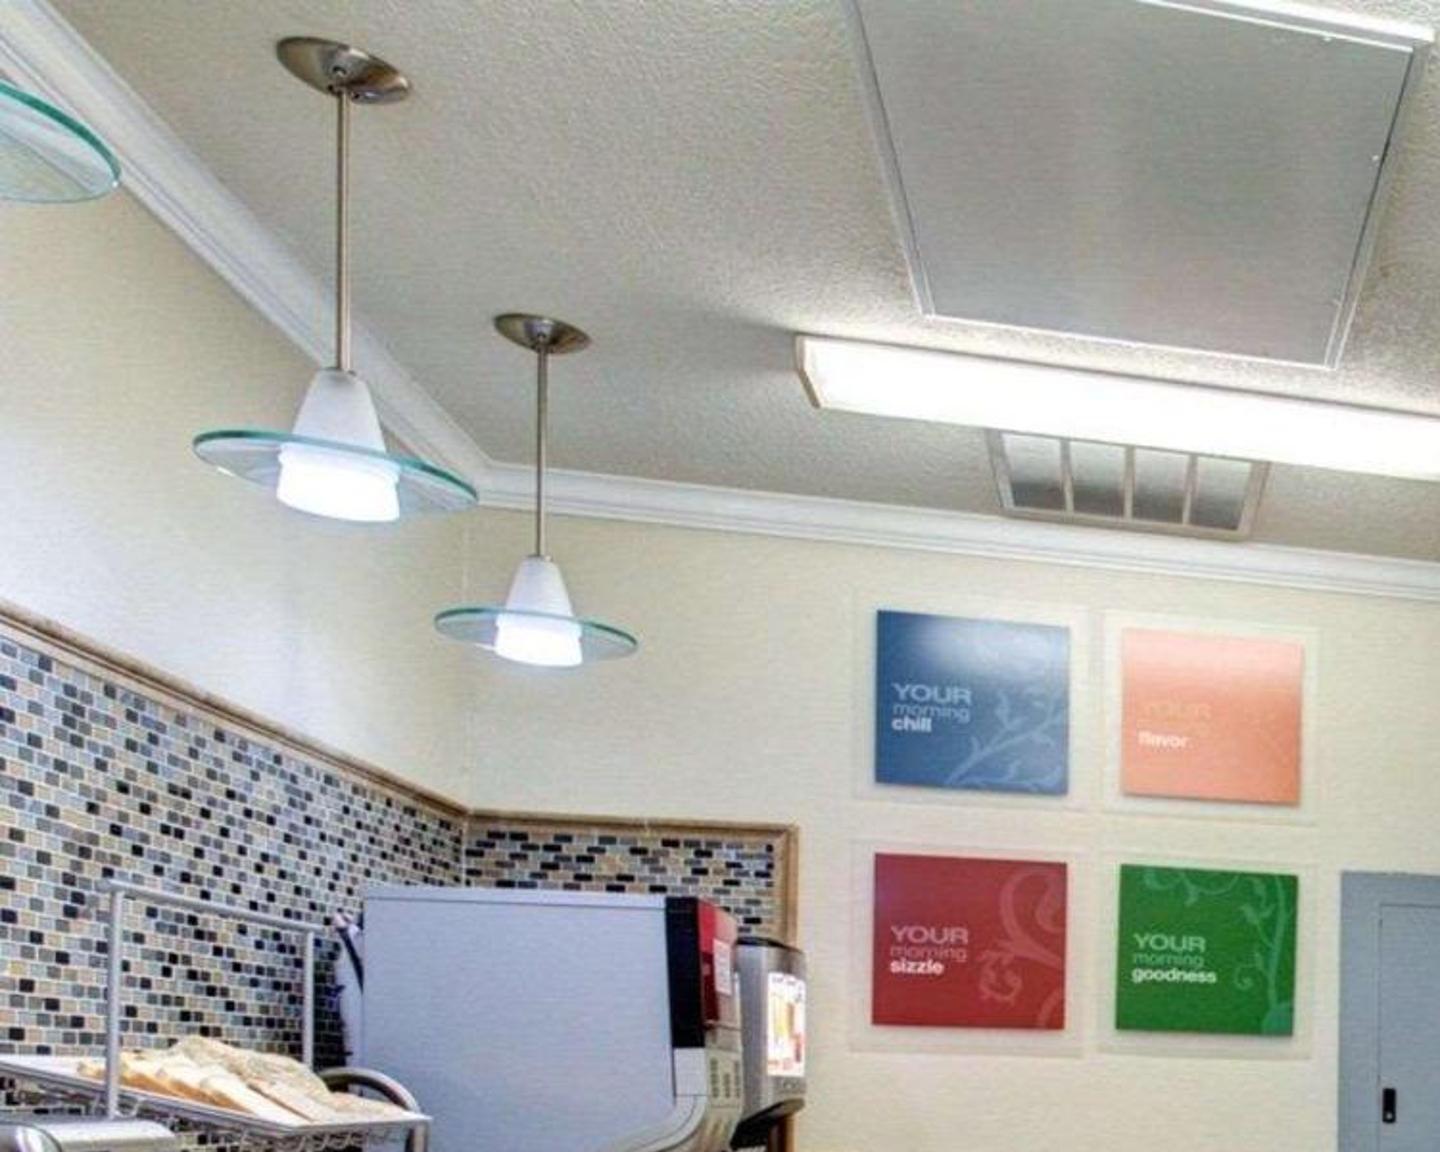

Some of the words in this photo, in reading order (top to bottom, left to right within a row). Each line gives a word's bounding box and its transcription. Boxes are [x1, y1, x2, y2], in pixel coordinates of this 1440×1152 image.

[891, 682, 972, 706] YOUR
[893, 704, 970, 724] morning
[892, 715, 932, 732] chill
[890, 925, 969, 946] YOUR
[1133, 932, 1206, 953] YOUR
[890, 946, 967, 964] morning
[1134, 953, 1205, 970] morning
[890, 958, 945, 976] sizzle
[1131, 967, 1217, 984] goodness
